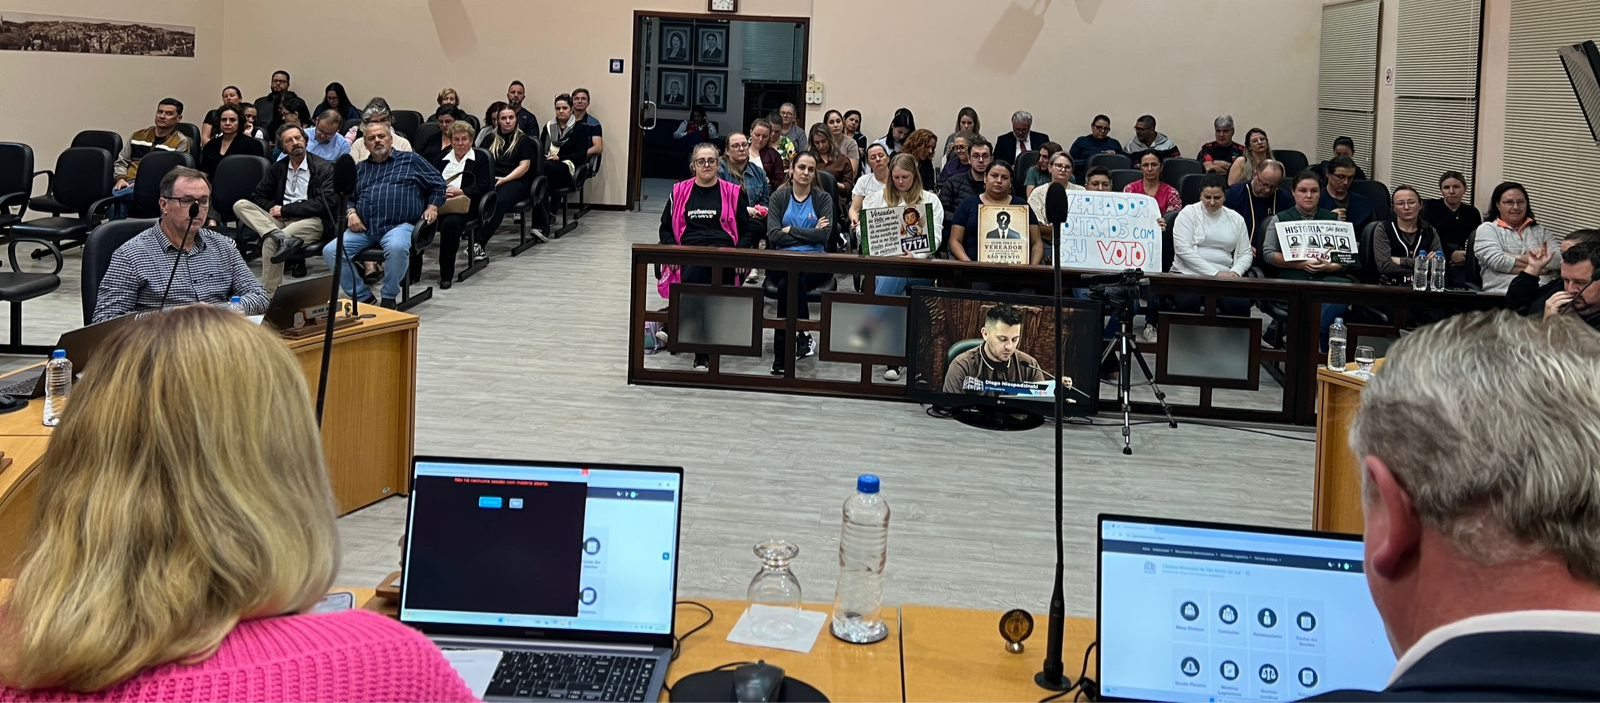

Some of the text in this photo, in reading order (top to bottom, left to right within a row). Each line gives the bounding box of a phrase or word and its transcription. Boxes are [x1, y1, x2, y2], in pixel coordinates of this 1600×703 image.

[870, 209, 896, 218] Vereador
[1061, 216, 1155, 239] ONTAMOS COM
[902, 238, 928, 251] 17171
[1291, 252, 1330, 260] ECAÇÃO
